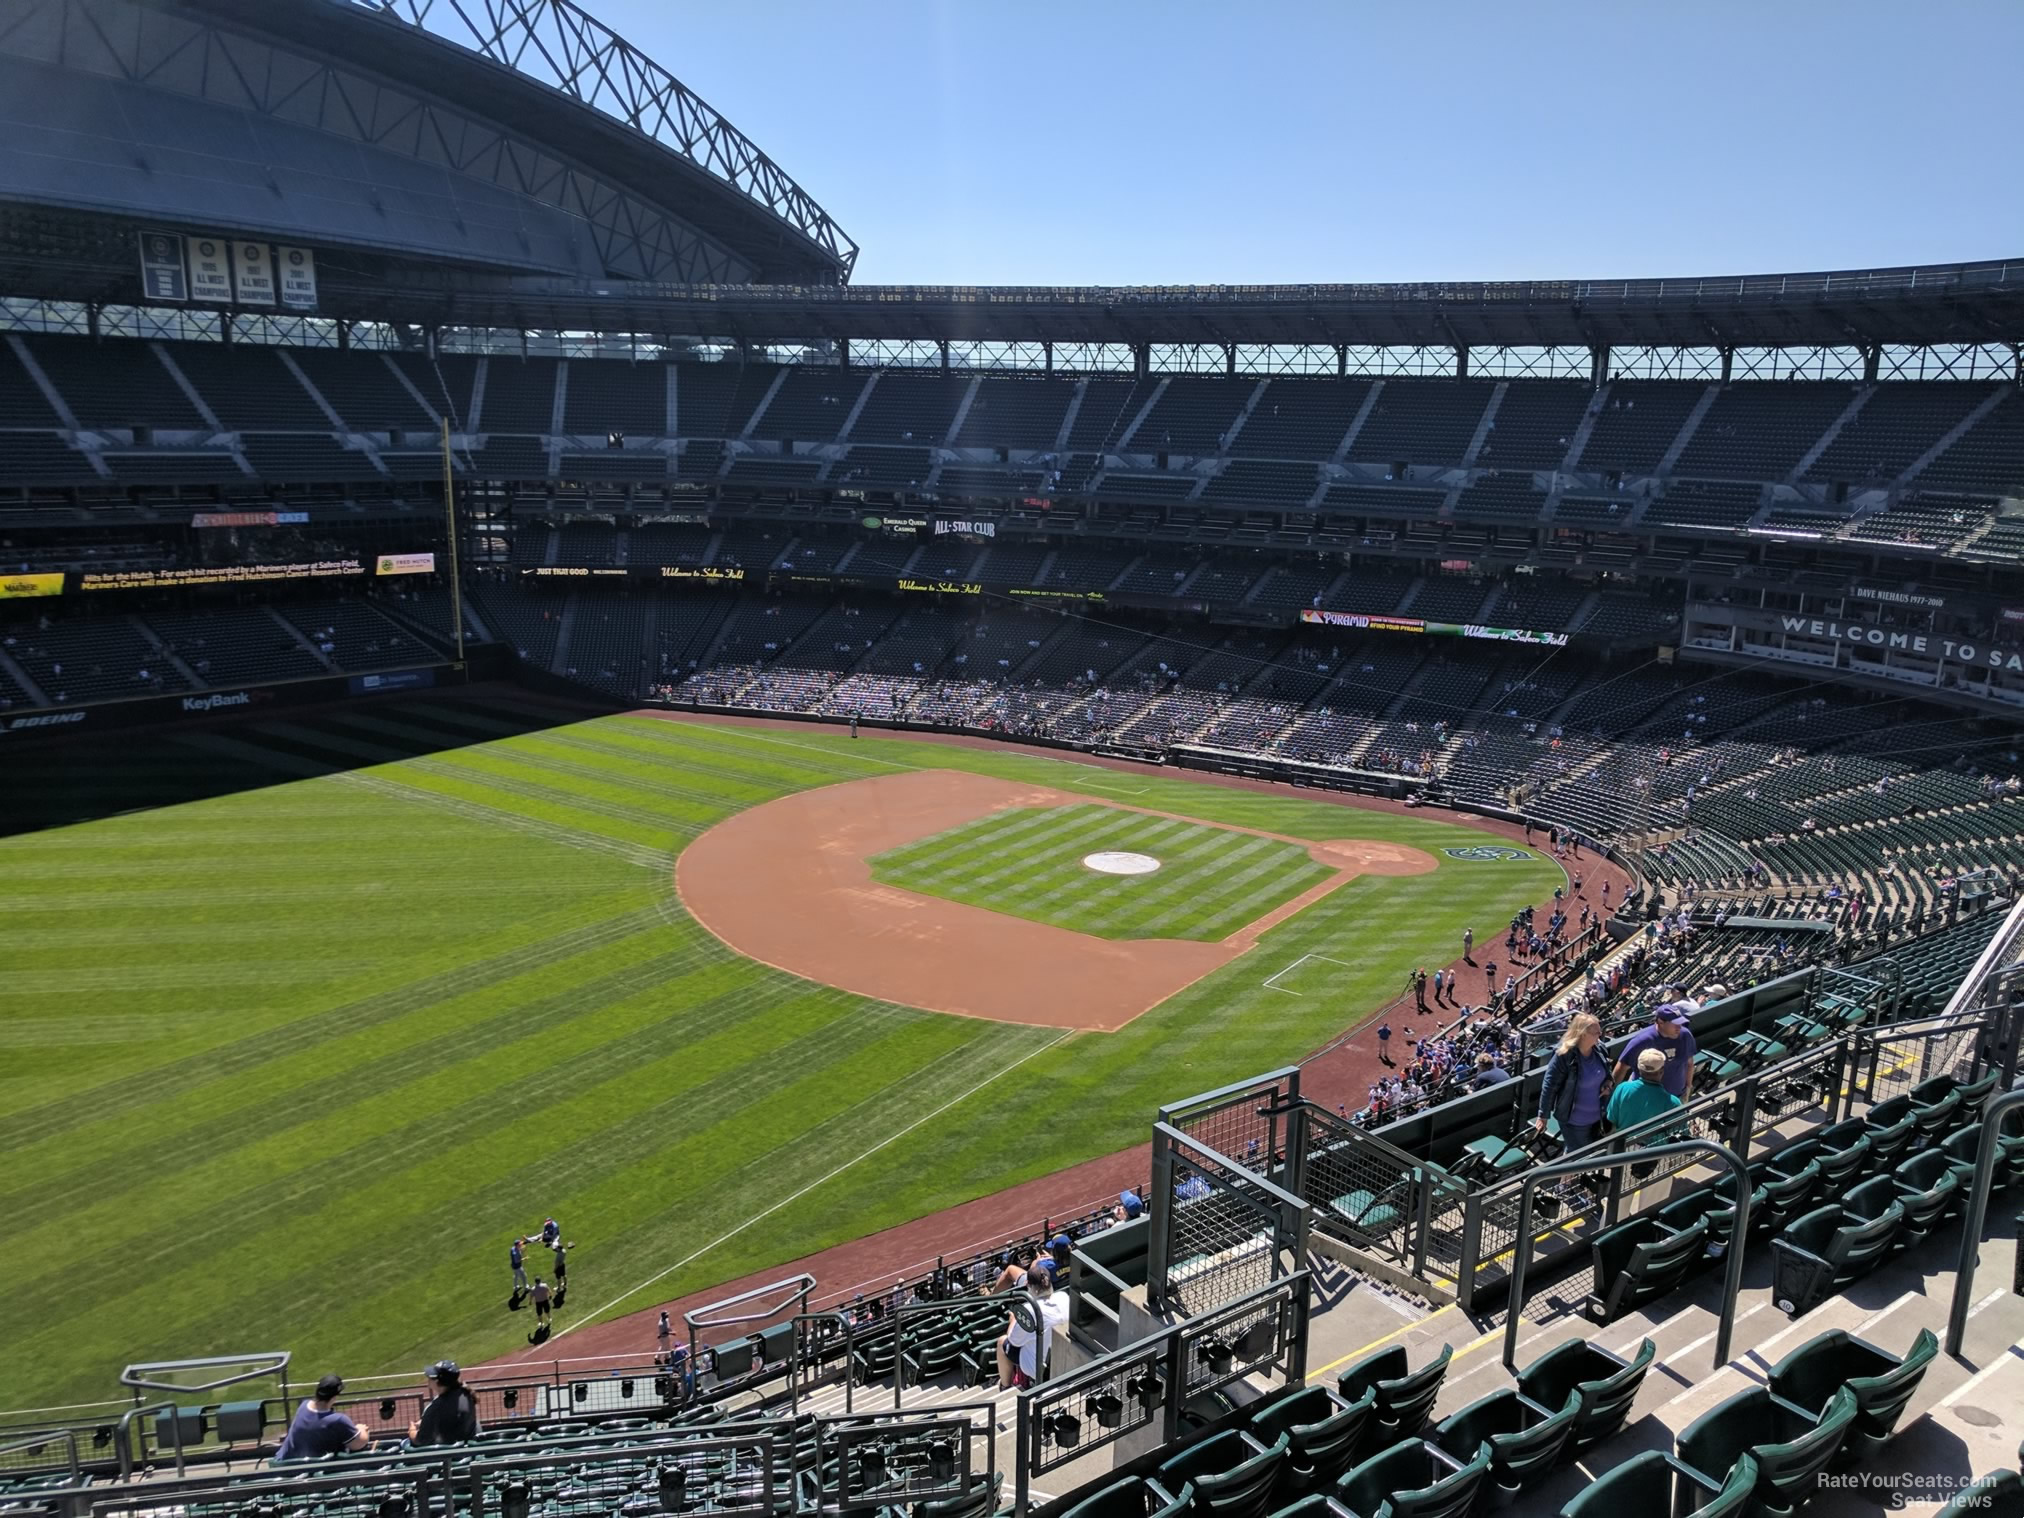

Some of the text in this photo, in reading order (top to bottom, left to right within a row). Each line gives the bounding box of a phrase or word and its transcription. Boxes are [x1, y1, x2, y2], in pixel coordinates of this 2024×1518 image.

[208, 275, 225, 284] WEST
[252, 278, 269, 288] WEST
[296, 281, 312, 290] WEST
[194, 287, 230, 297] CHAMPIONS
[240, 290, 273, 300] CHAMPIONS
[284, 292, 316, 303] CHAMPIONS
[883, 517, 927, 527] EMERALD QUEEN
[893, 525, 917, 533] CASINOS
[973, 521, 996, 538] CLUB
[116, 573, 129, 581] the
[160, 570, 174, 578] For
[175, 569, 194, 577] each
[206, 566, 240, 576] recorded
[256, 564, 287, 573] Mariners
[319, 560, 341, 569] Safeco
[552, 568, 569, 576] THAT
[569, 568, 589, 576] GOOD
[661, 567, 744, 580] Welcome to Safeco Field
[81, 582, 119, 591] Mariners
[156, 578, 177, 586] make
[185, 576, 218, 585] donation
[227, 573, 245, 581] Fred
[246, 571, 286, 580] Hutchinson
[287, 569, 310, 578] Cancer
[311, 568, 342, 577] Research
[343, 567, 365, 575] Center
[898, 580, 982, 595] Welcome to Safeco Field
[1857, 588, 1944, 607] DAVE NIEHAUS 1977-2010
[1323, 612, 1369, 628] PYRAMID
[1463, 624, 1569, 646] Welcome to Safeco Field
[1781, 615, 1928, 652] WELCOME
[1943, 640, 1976, 661] TO
[183, 692, 250, 711] KeyBank
[10, 712, 86, 728] BOEING
